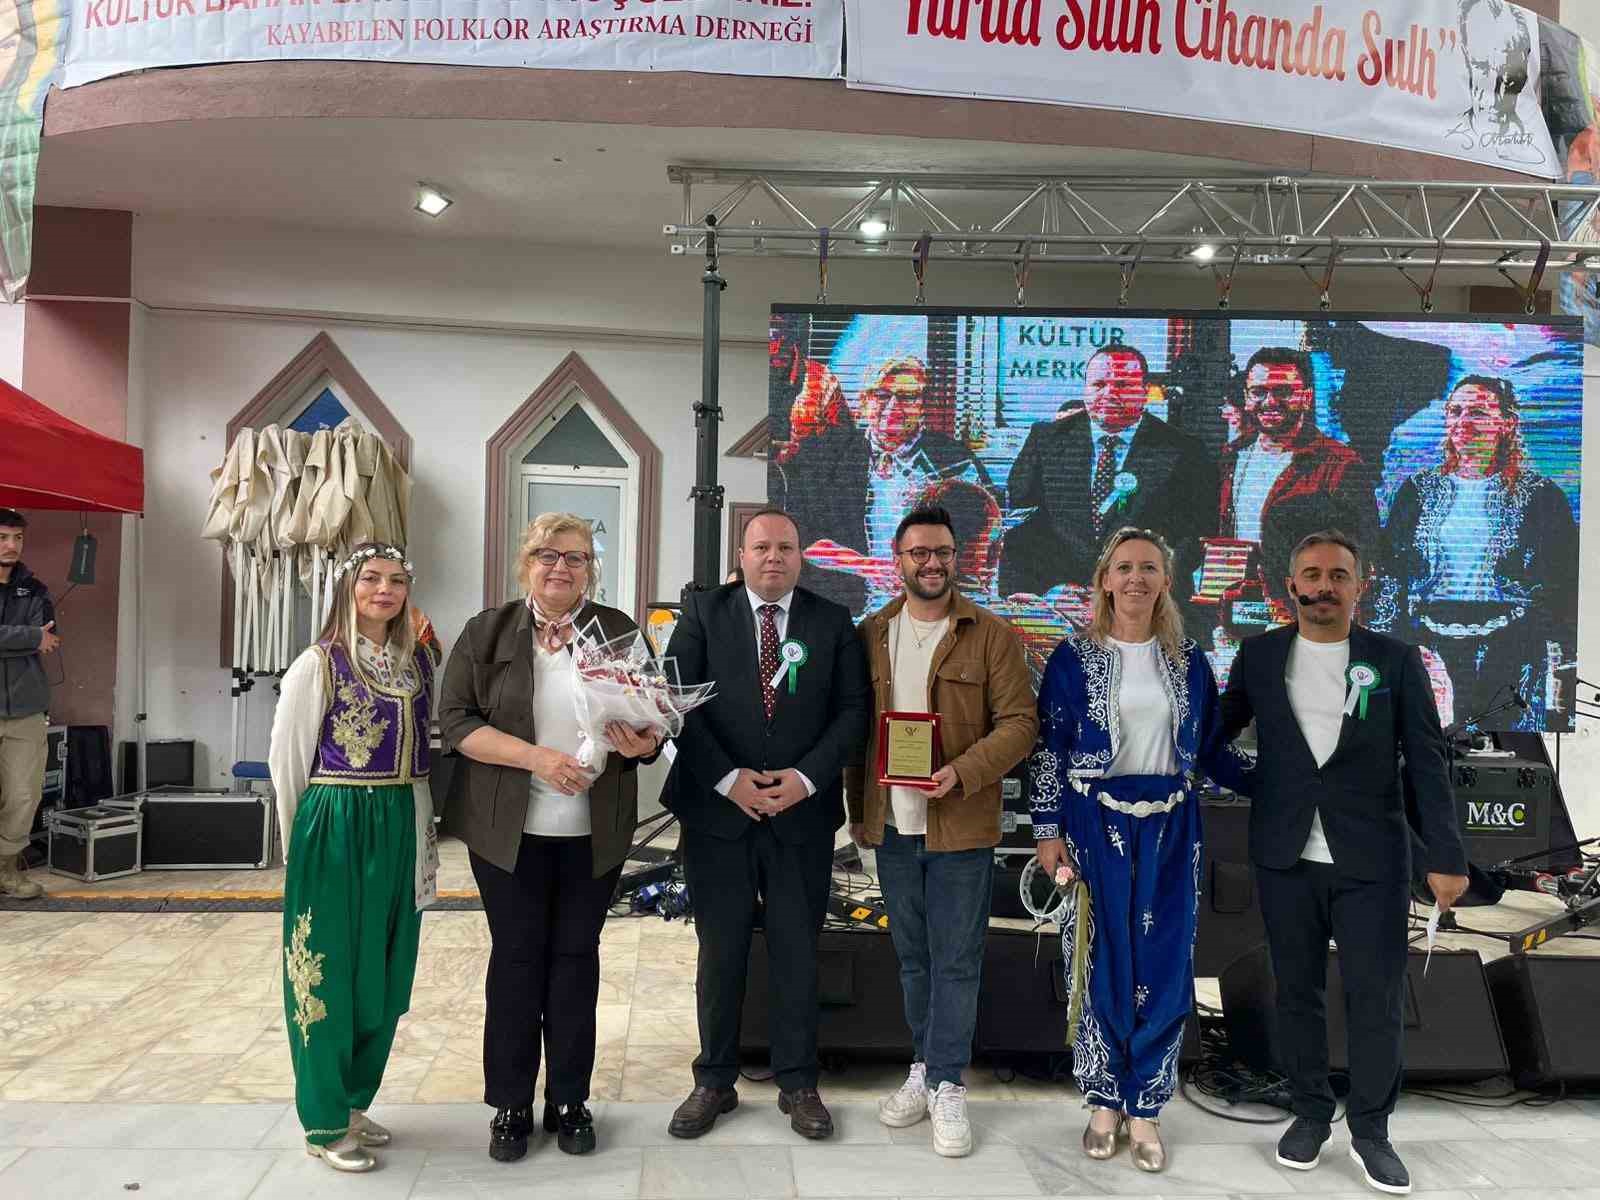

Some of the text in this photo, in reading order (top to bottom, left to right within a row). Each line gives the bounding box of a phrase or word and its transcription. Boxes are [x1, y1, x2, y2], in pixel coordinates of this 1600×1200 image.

[267, 14, 813, 46] KAYABELEN FOLKLOR ARAŞTIRMA DERNEĞİ
[1018, 319, 1126, 346] KÜLTÜR
[1466, 801, 1526, 827] M&C
